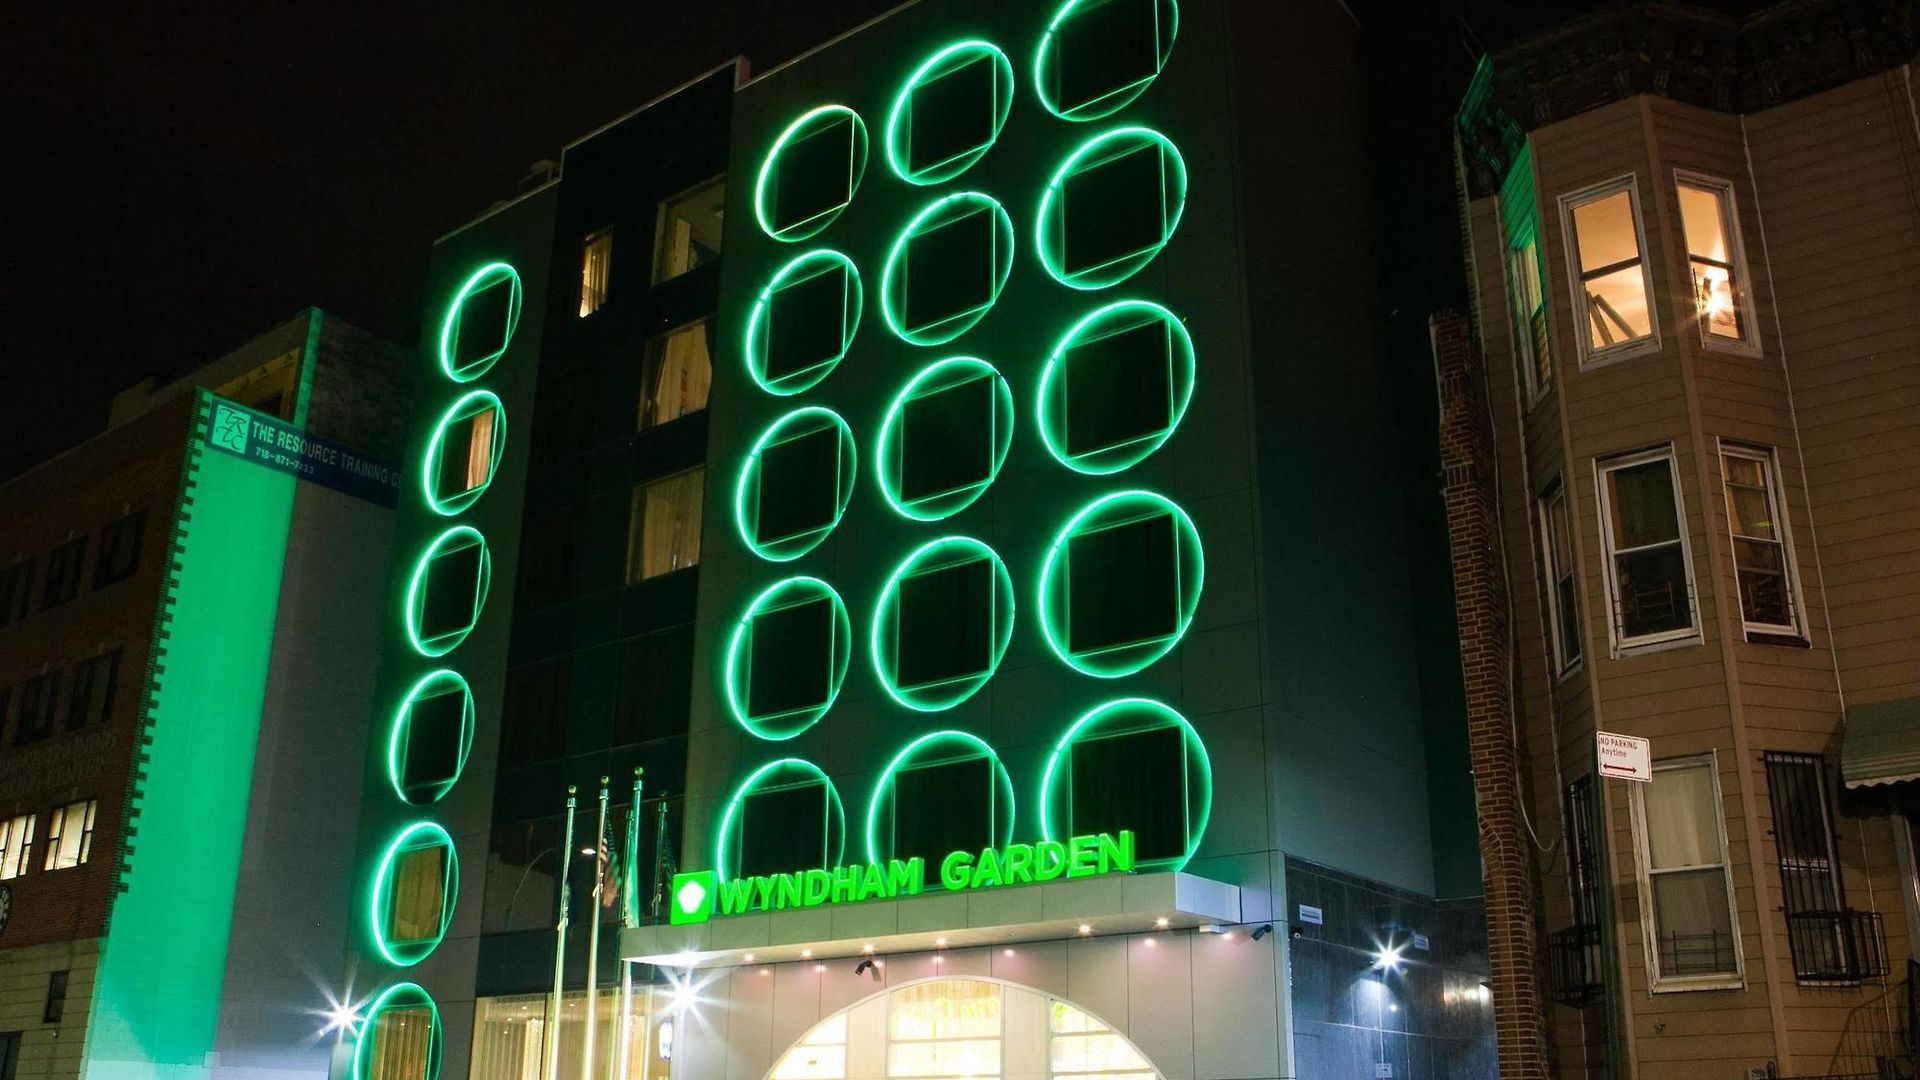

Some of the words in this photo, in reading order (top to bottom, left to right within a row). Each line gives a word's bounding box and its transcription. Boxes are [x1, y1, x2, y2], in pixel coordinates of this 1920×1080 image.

[253, 421, 275, 445] THE
[277, 430, 337, 466] RESOURCE
[341, 453, 389, 484] TRAINING
[1600, 737, 1610, 746] NO
[1611, 739, 1638, 749] PARKING
[1602, 747, 1627, 757] Anytime
[719, 857, 924, 914] WYNDHAM
[941, 830, 1135, 892] GARDEN
